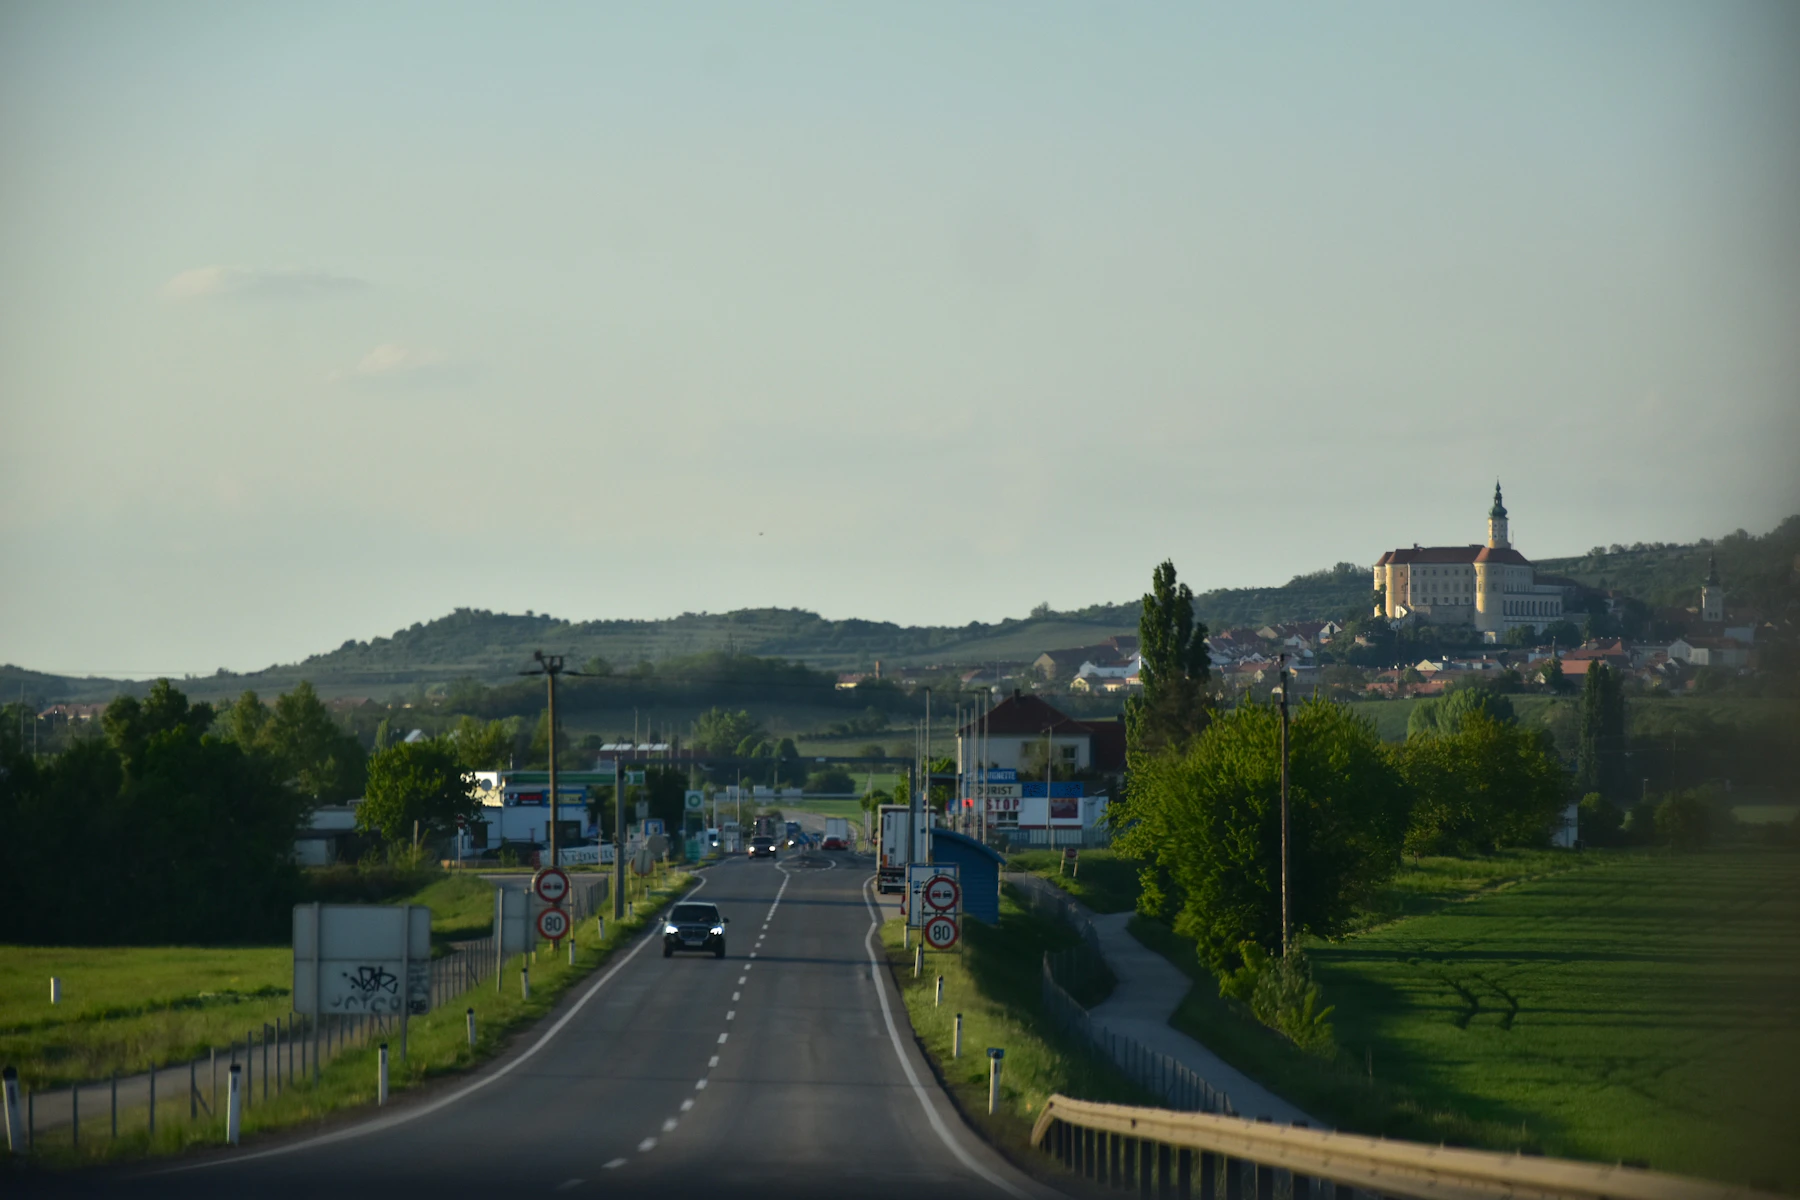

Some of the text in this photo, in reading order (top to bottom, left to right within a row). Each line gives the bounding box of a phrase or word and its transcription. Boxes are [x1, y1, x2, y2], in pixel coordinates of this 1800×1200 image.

[987, 798, 1020, 810] STOP
[545, 916, 561, 932] 80
[933, 925, 950, 940] 80
